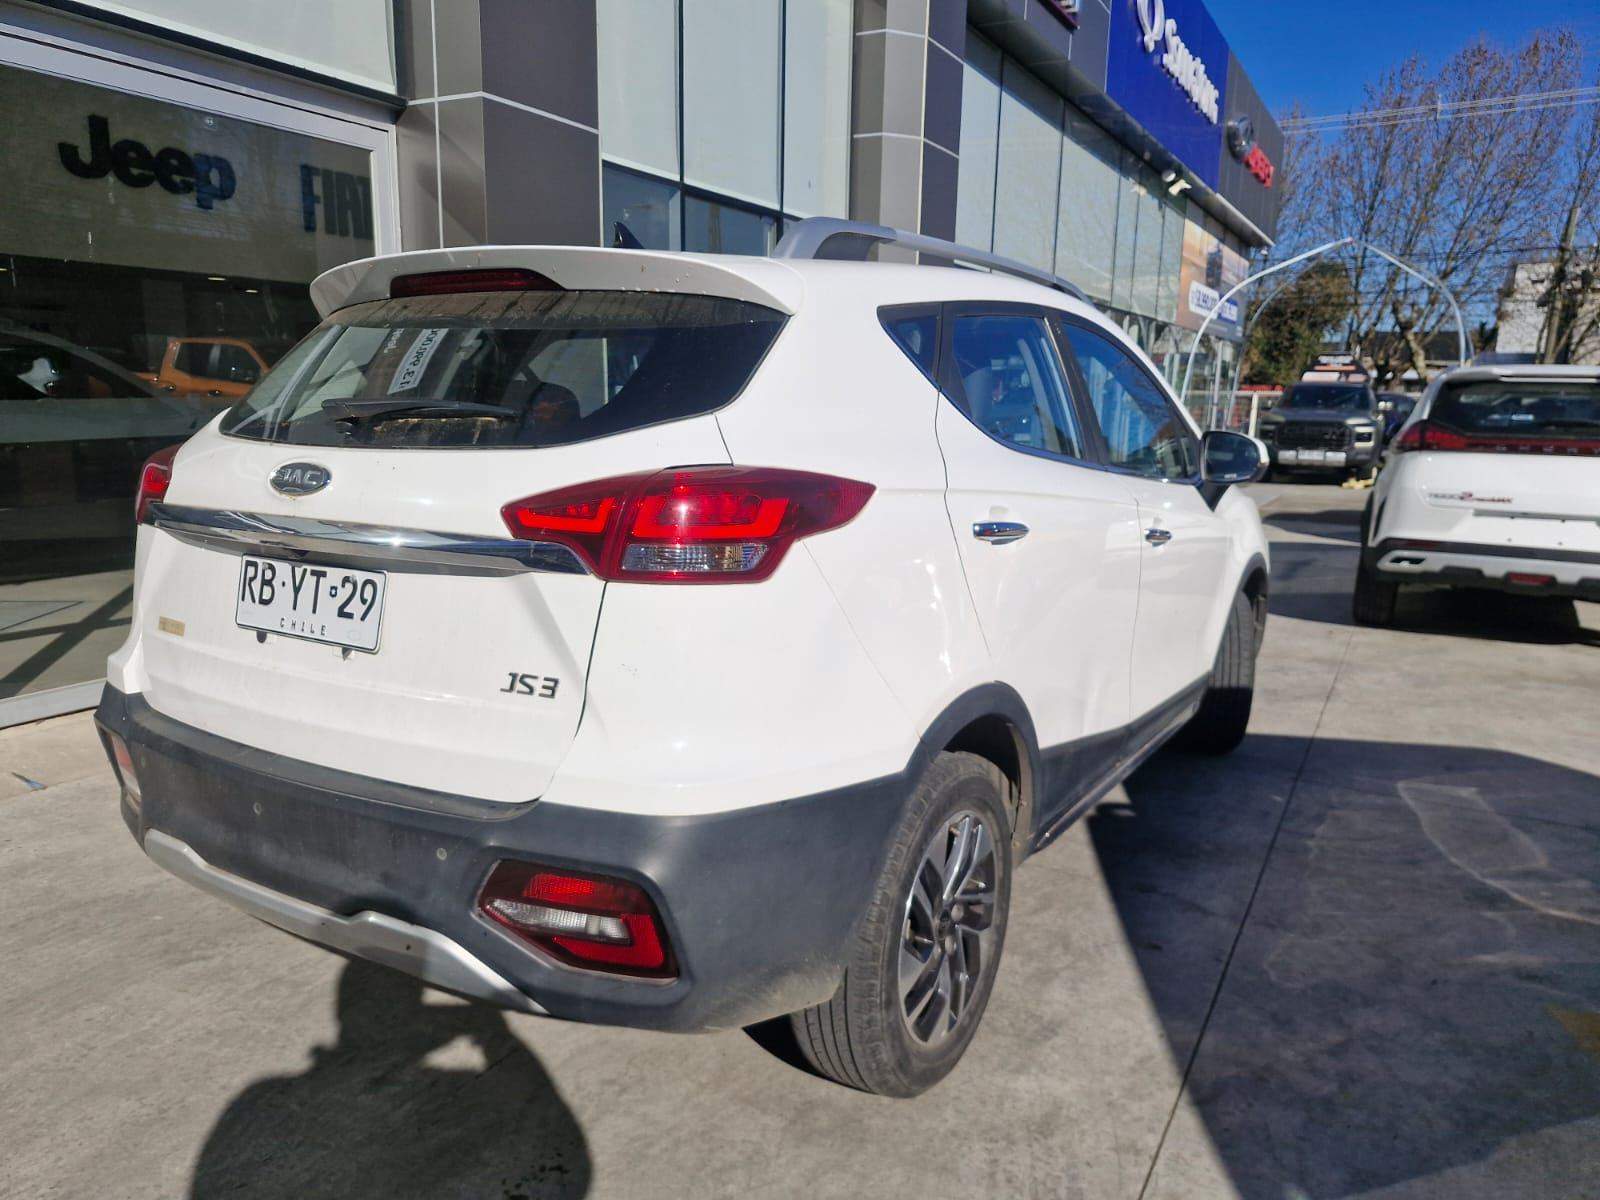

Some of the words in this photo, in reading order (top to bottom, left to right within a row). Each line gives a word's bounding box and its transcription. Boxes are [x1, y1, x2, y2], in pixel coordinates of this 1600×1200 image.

[57, 114, 237, 210] Jeep
[279, 617, 327, 636] CHILE
[499, 672, 559, 699] JS3
